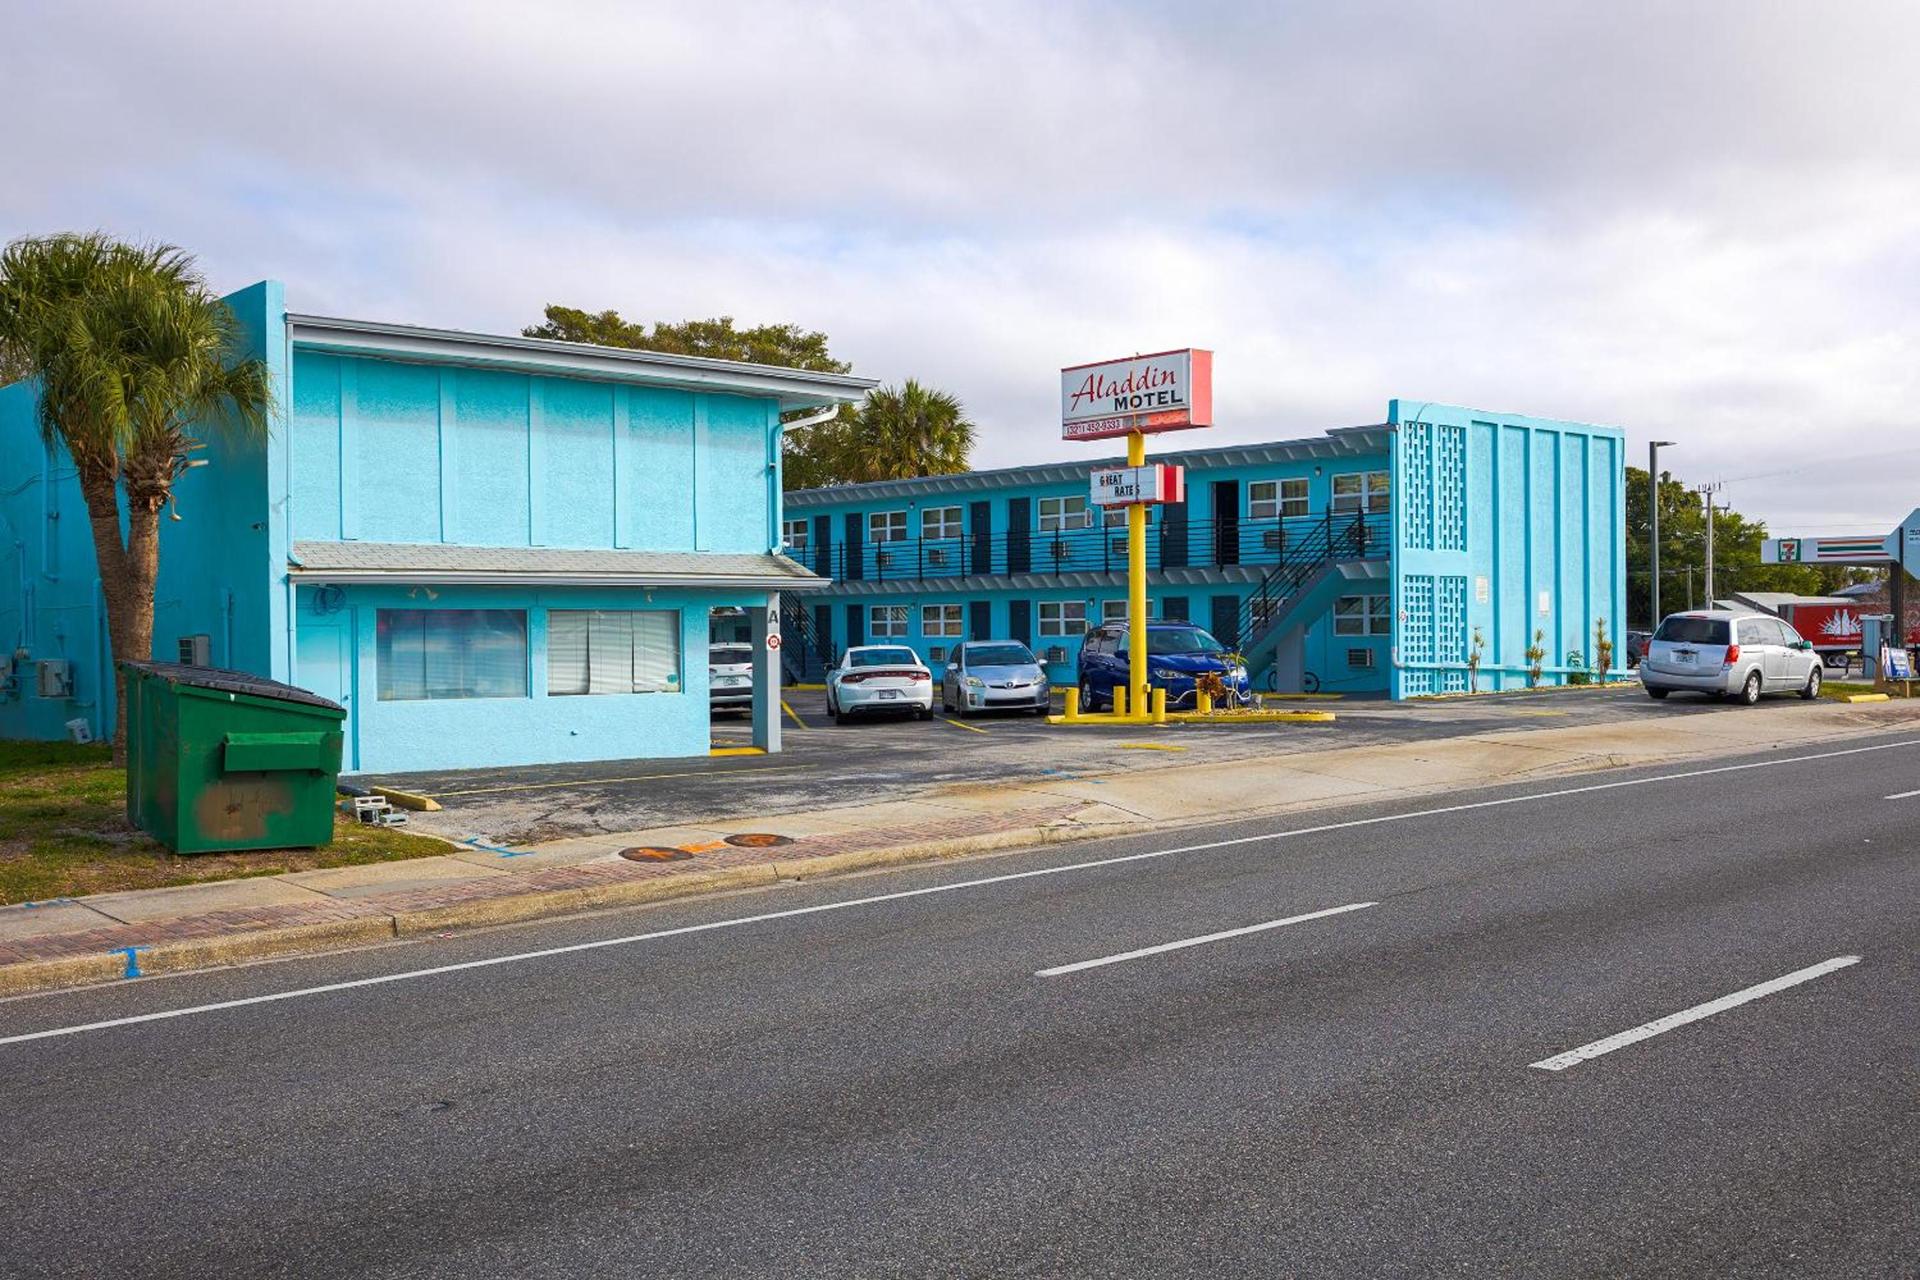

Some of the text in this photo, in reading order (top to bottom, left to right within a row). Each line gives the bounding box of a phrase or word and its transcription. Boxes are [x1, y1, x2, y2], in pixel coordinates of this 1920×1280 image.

[1071, 366, 1176, 411] Aladdin
[1114, 390, 1183, 411] MOTEL
[1100, 474, 1122, 486] GREAT
[768, 610, 778, 624] A
